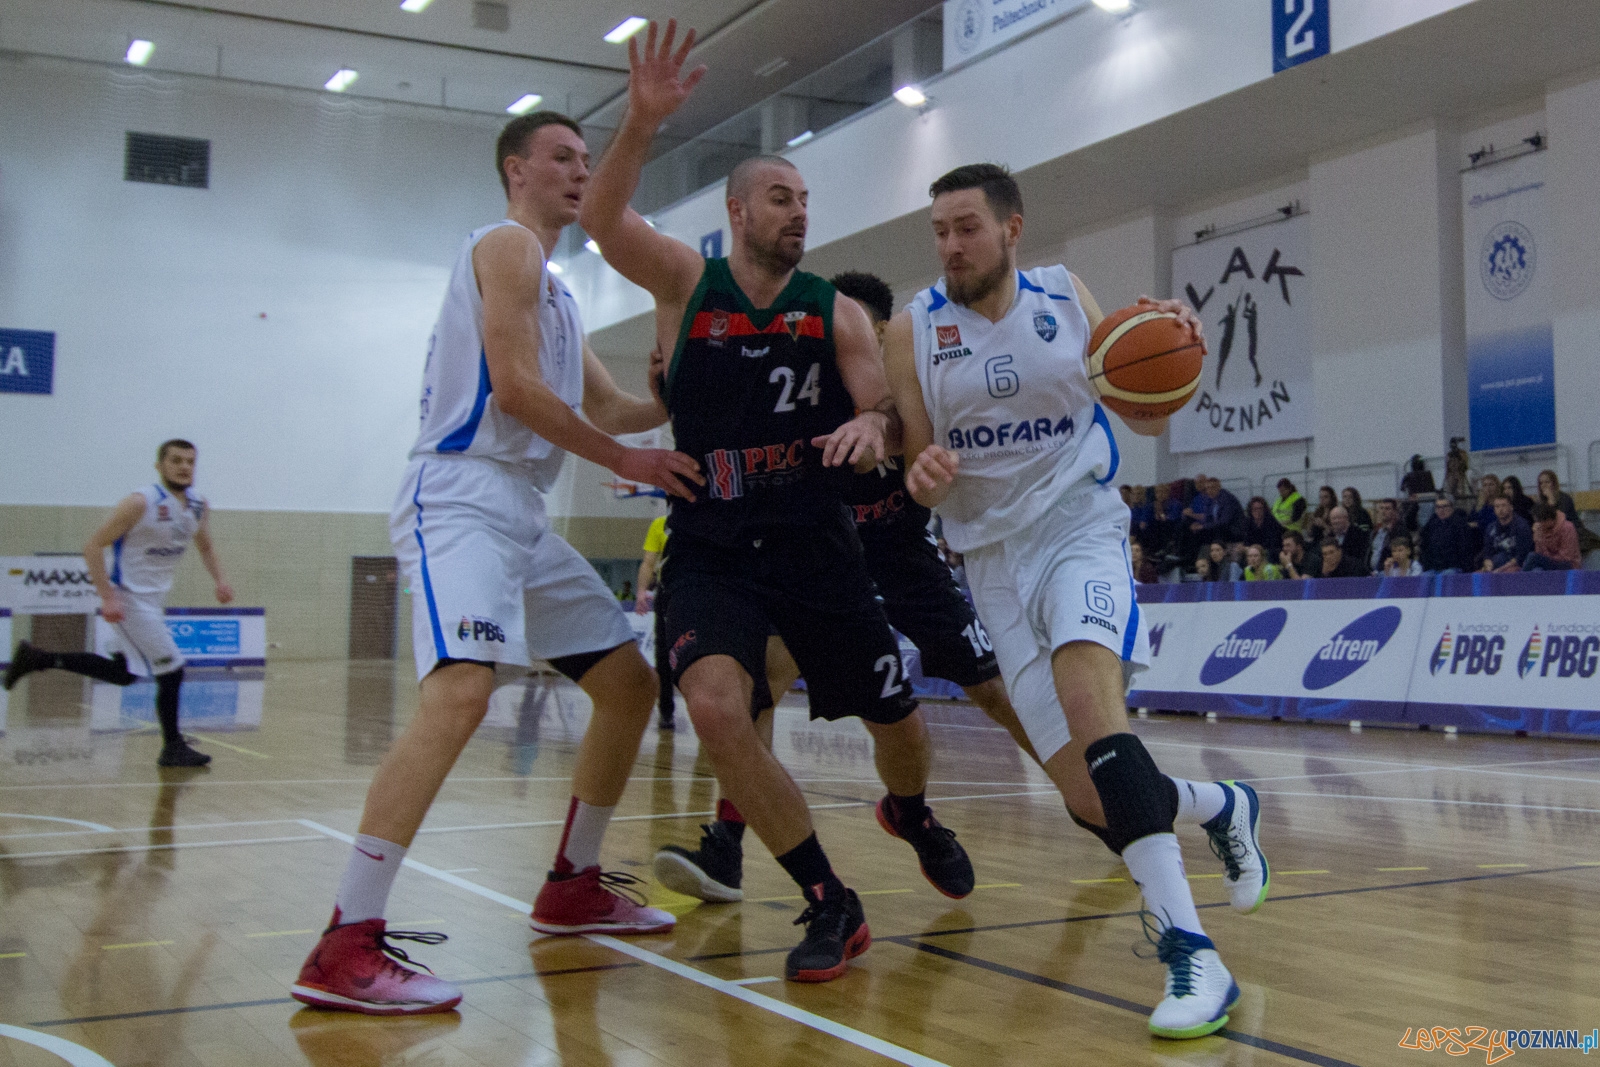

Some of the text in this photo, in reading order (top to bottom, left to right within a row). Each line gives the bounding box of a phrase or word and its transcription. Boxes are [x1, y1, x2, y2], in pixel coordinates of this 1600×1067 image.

[1285, 0, 1315, 59] 2
[768, 362, 821, 413] 24
[984, 353, 1020, 399] 6
[1195, 380, 1291, 432] POZNAŃ
[948, 414, 1075, 449] BIOFARM
[741, 439, 804, 475] PEC
[852, 490, 905, 523] PEC
[1084, 579, 1115, 618] 6
[472, 620, 506, 643] PBG
[960, 618, 993, 658] 16
[1214, 633, 1268, 659] atrem
[1318, 633, 1380, 661] atrem
[1450, 634, 1506, 676] PBG
[1540, 635, 1600, 679] PBG
